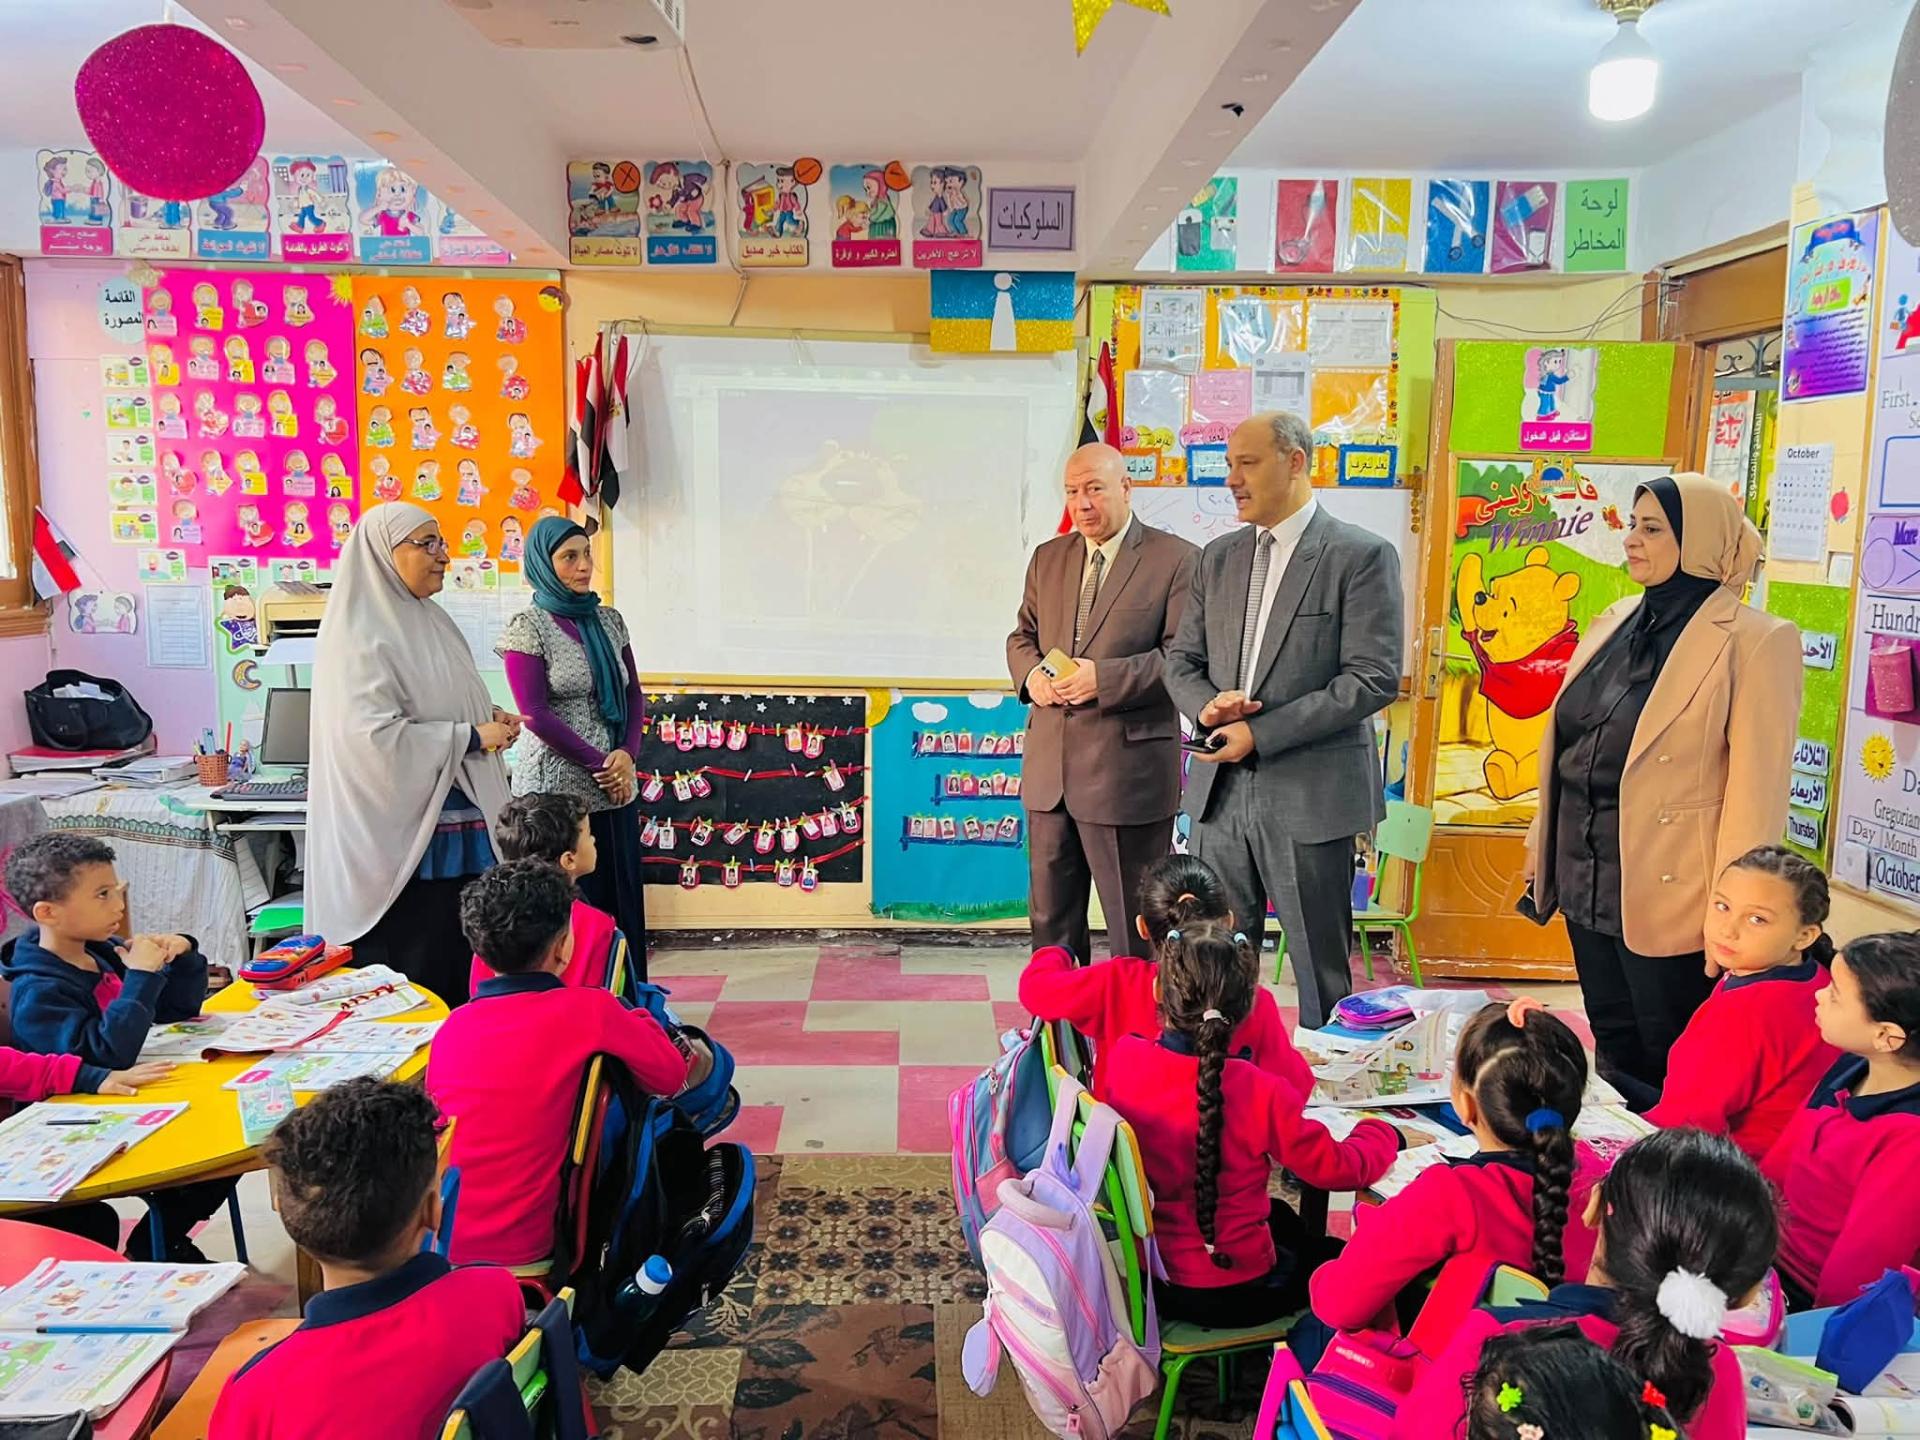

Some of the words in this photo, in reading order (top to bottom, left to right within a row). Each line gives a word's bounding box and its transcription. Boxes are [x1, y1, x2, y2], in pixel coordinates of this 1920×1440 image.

[1580, 186, 1618, 218] لوحة
[997, 199, 1064, 241] السلوكيات
[741, 244, 764, 259] صديق
[766, 244, 780, 258] خير
[1566, 227, 1625, 259] المخاطر
[105, 287, 136, 303] القائمة
[1881, 390, 1910, 409] First
[1787, 447, 1820, 459] October
[1488, 505, 1594, 553] Winnie
[1893, 521, 1918, 546] More
[1794, 742, 1825, 767] الثلاثاء
[1790, 779, 1823, 804] الأربعاء
[1874, 798, 1920, 830] Gregorian
[1852, 820, 1876, 845] Day
[1884, 831, 1917, 858] Month
[1875, 856, 1920, 894] October
